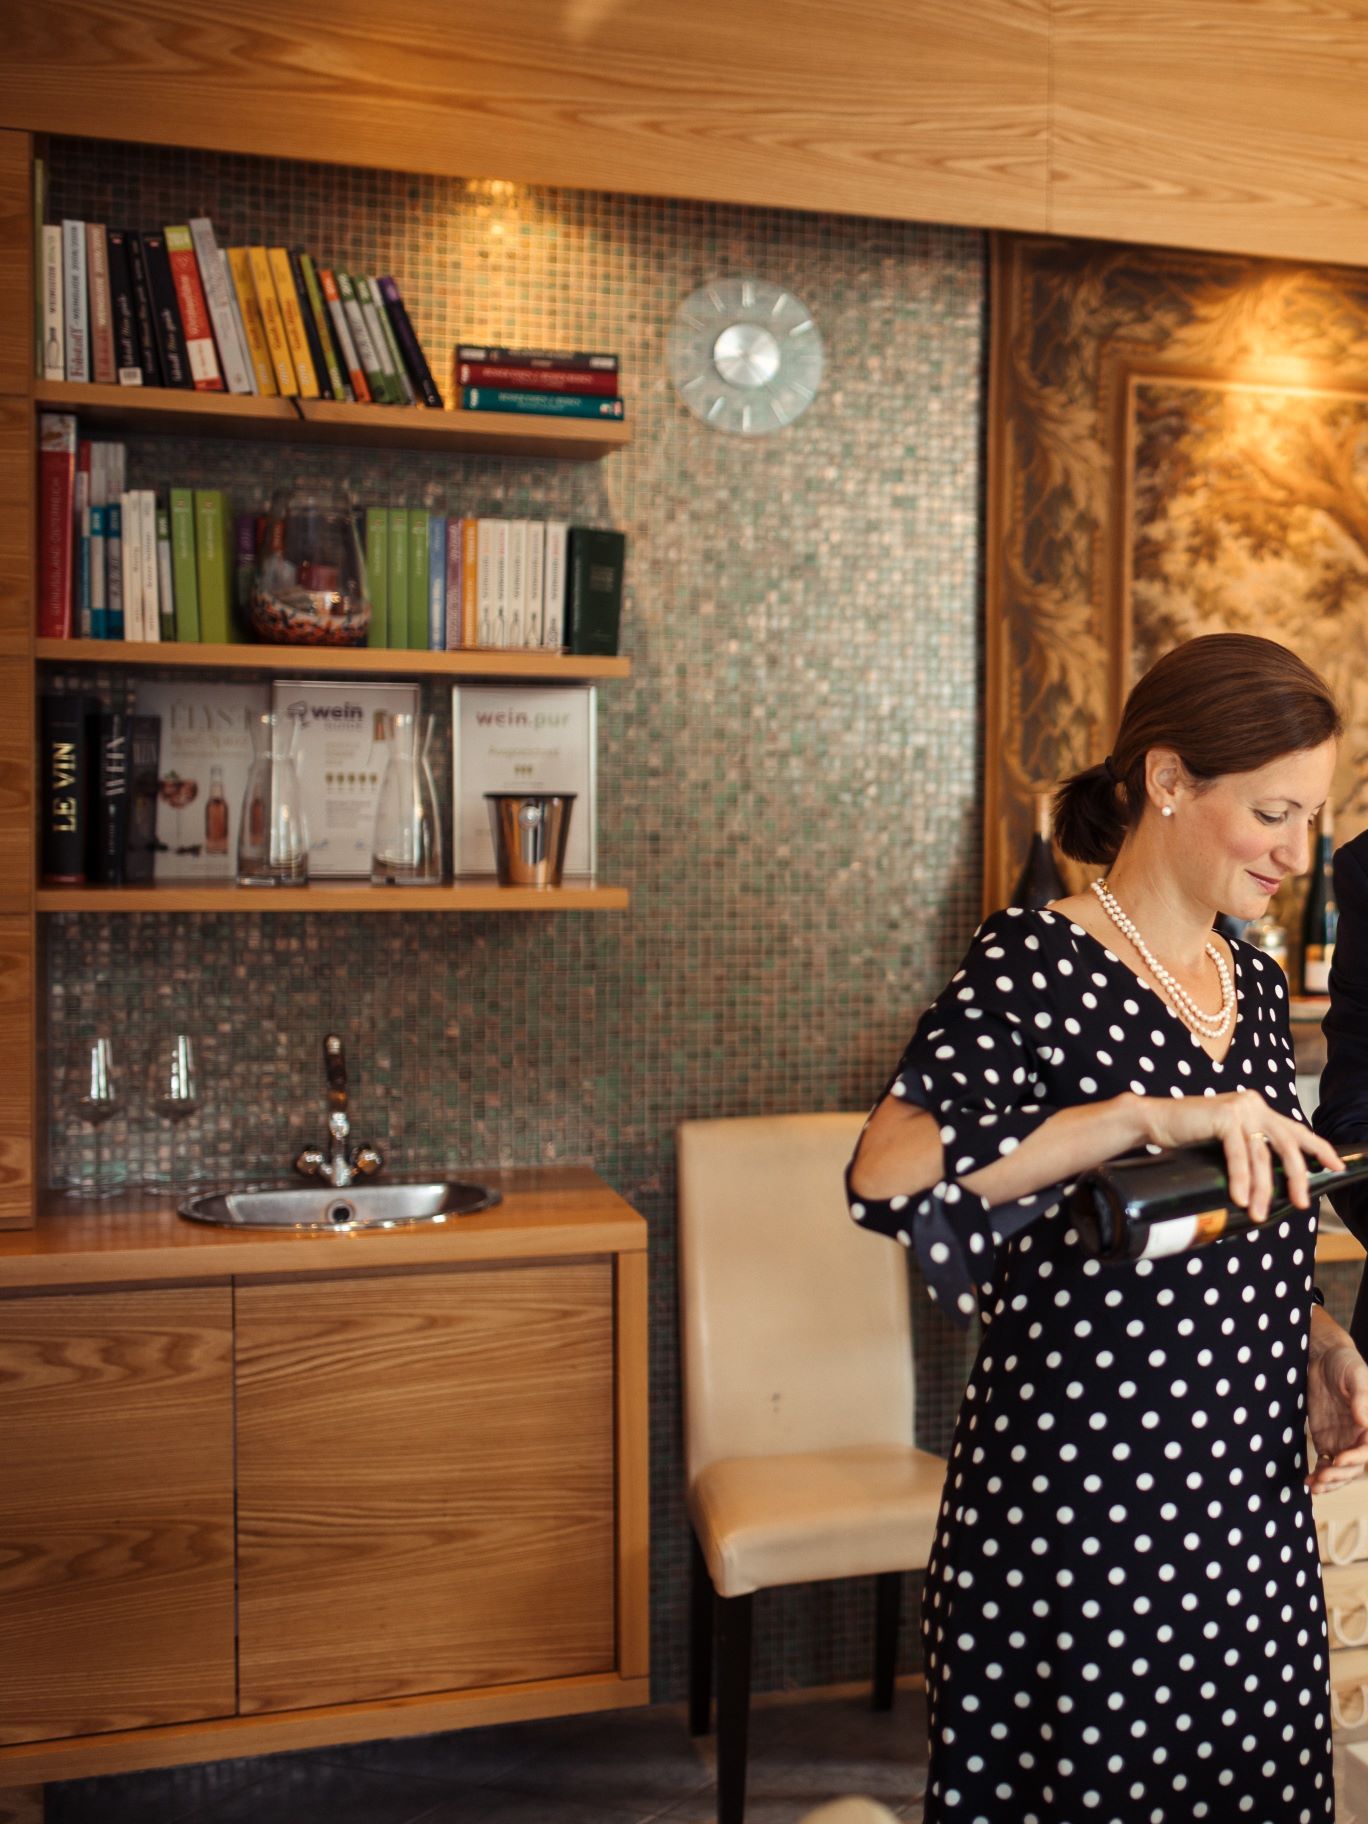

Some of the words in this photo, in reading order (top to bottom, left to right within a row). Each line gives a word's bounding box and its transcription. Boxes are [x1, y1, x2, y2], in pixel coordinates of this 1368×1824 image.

[311, 702, 363, 721] wein
[475, 707, 571, 731] wein.pur
[53, 742, 77, 790] VIN
[53, 797, 77, 833] LE
